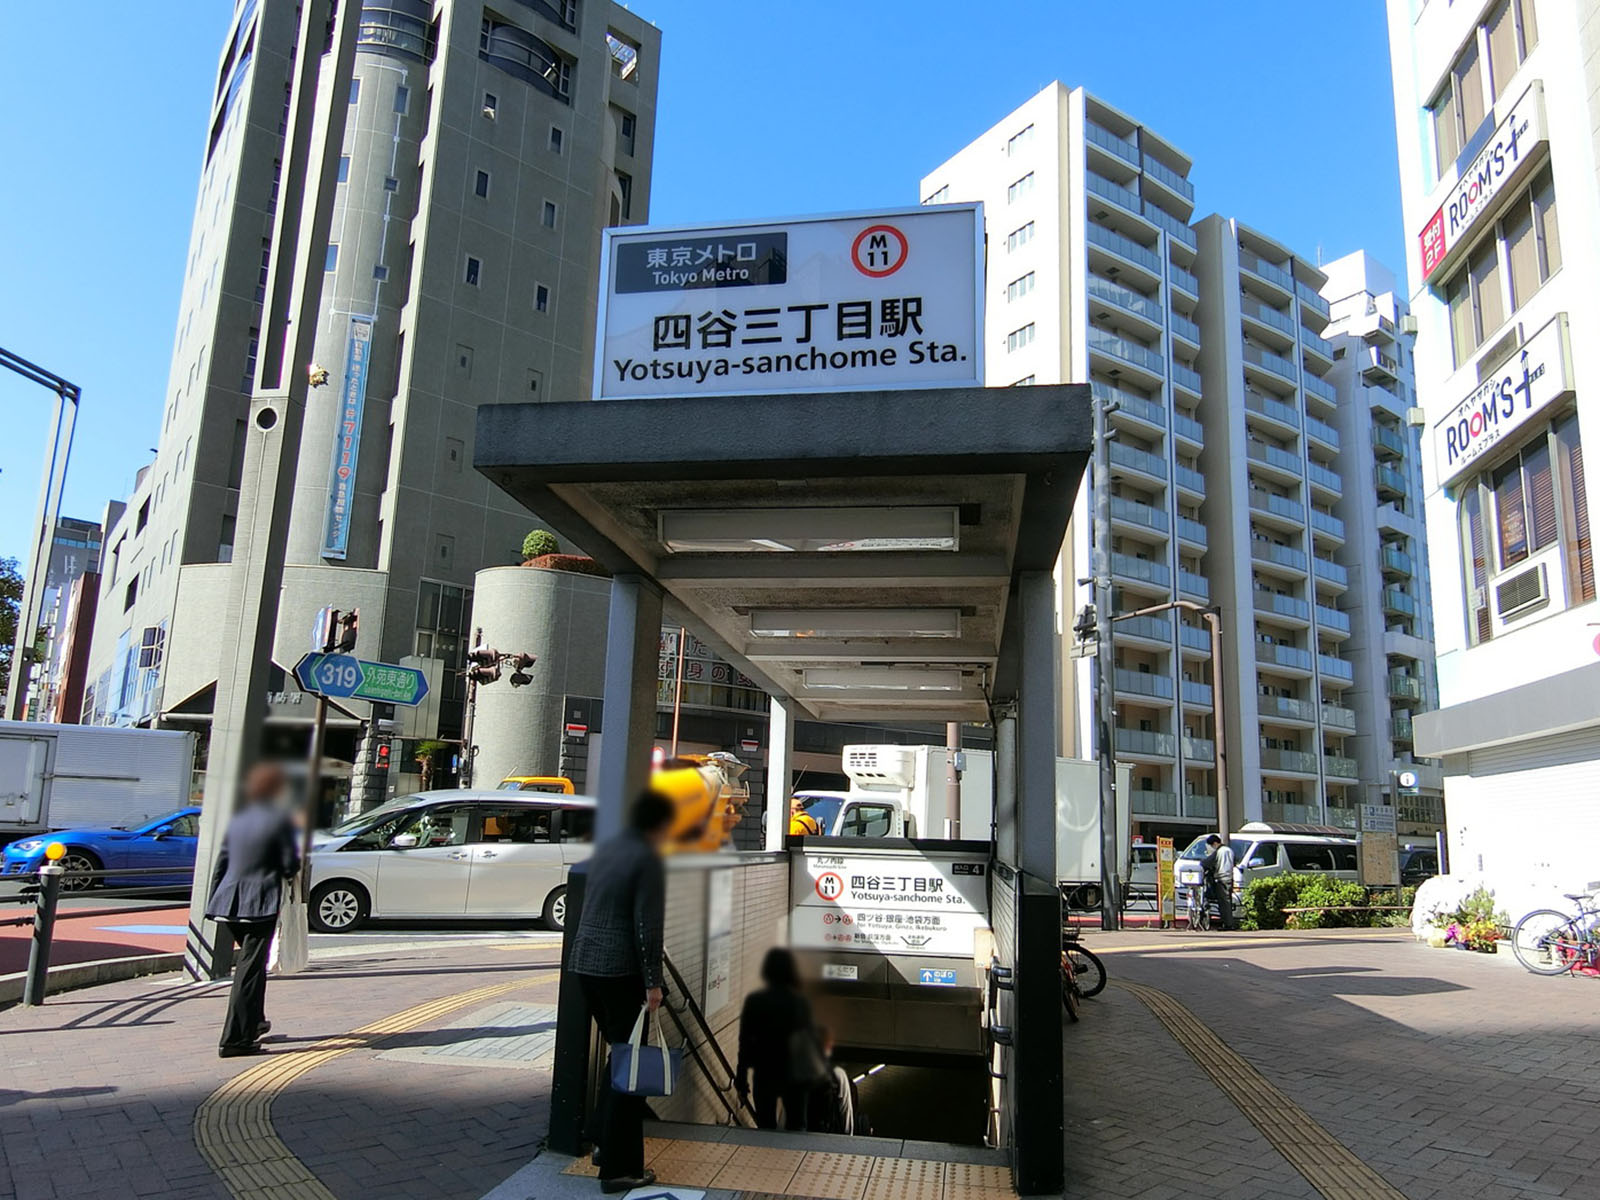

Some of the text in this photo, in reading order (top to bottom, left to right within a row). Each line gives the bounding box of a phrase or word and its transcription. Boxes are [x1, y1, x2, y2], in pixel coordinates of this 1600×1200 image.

[870, 236, 888, 249] M
[646, 242, 757, 269] 東京メトロ
[868, 251, 889, 266] 11
[1426, 239, 1441, 270] 2F
[653, 266, 749, 287] Tokyo Metro
[653, 296, 923, 352] 四谷三丁目駅
[614, 341, 967, 383] Yotsuya-sanchome Sta.
[321, 663, 357, 689] 319
[972, 864, 980, 875] 4
[825, 876, 834, 884] M
[851, 875, 944, 893] 四谷三丁目駅
[824, 885, 834, 894] 11
[851, 890, 966, 904] Yotsuya-sanchome Sta.
